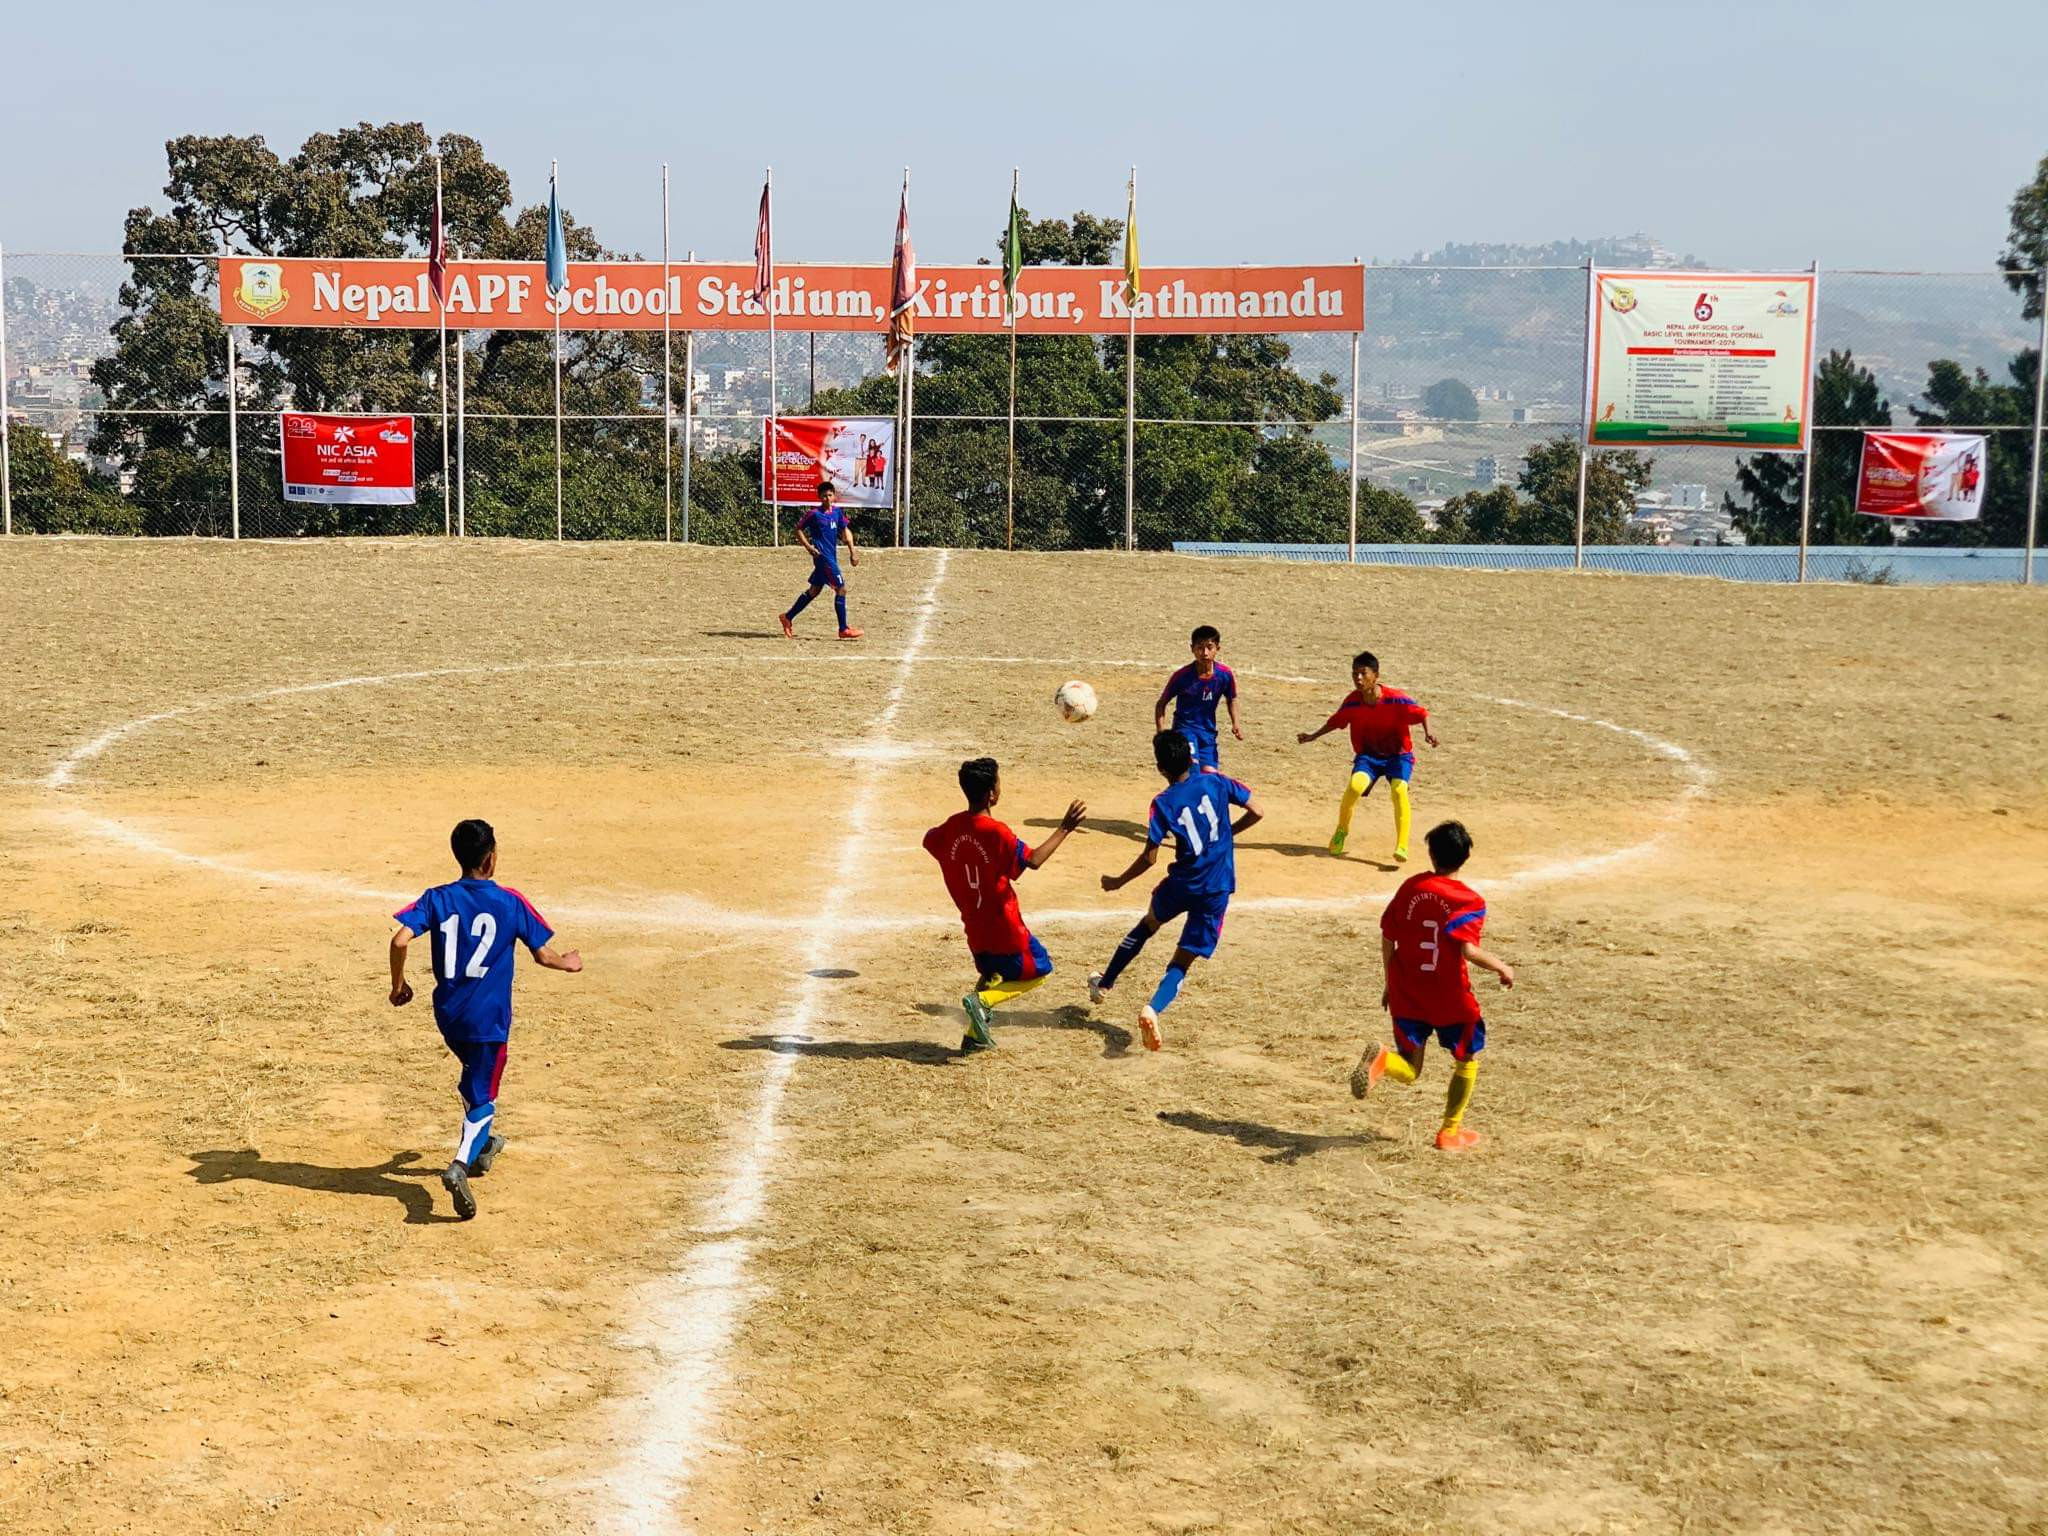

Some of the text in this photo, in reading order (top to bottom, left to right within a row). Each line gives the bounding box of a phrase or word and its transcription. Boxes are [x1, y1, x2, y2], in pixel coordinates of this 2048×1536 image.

[312, 272, 431, 321] Nepal
[445, 274, 532, 314] APF
[544, 276, 682, 315] School
[697, 276, 886, 323] Stadium,
[1098, 277, 1344, 319] Kathmandu
[317, 444, 378, 457] NIC ASIA
[1177, 794, 1219, 857] 11
[964, 863, 983, 910] 4
[439, 912, 497, 979] 12
[1420, 920, 1439, 971] 3
